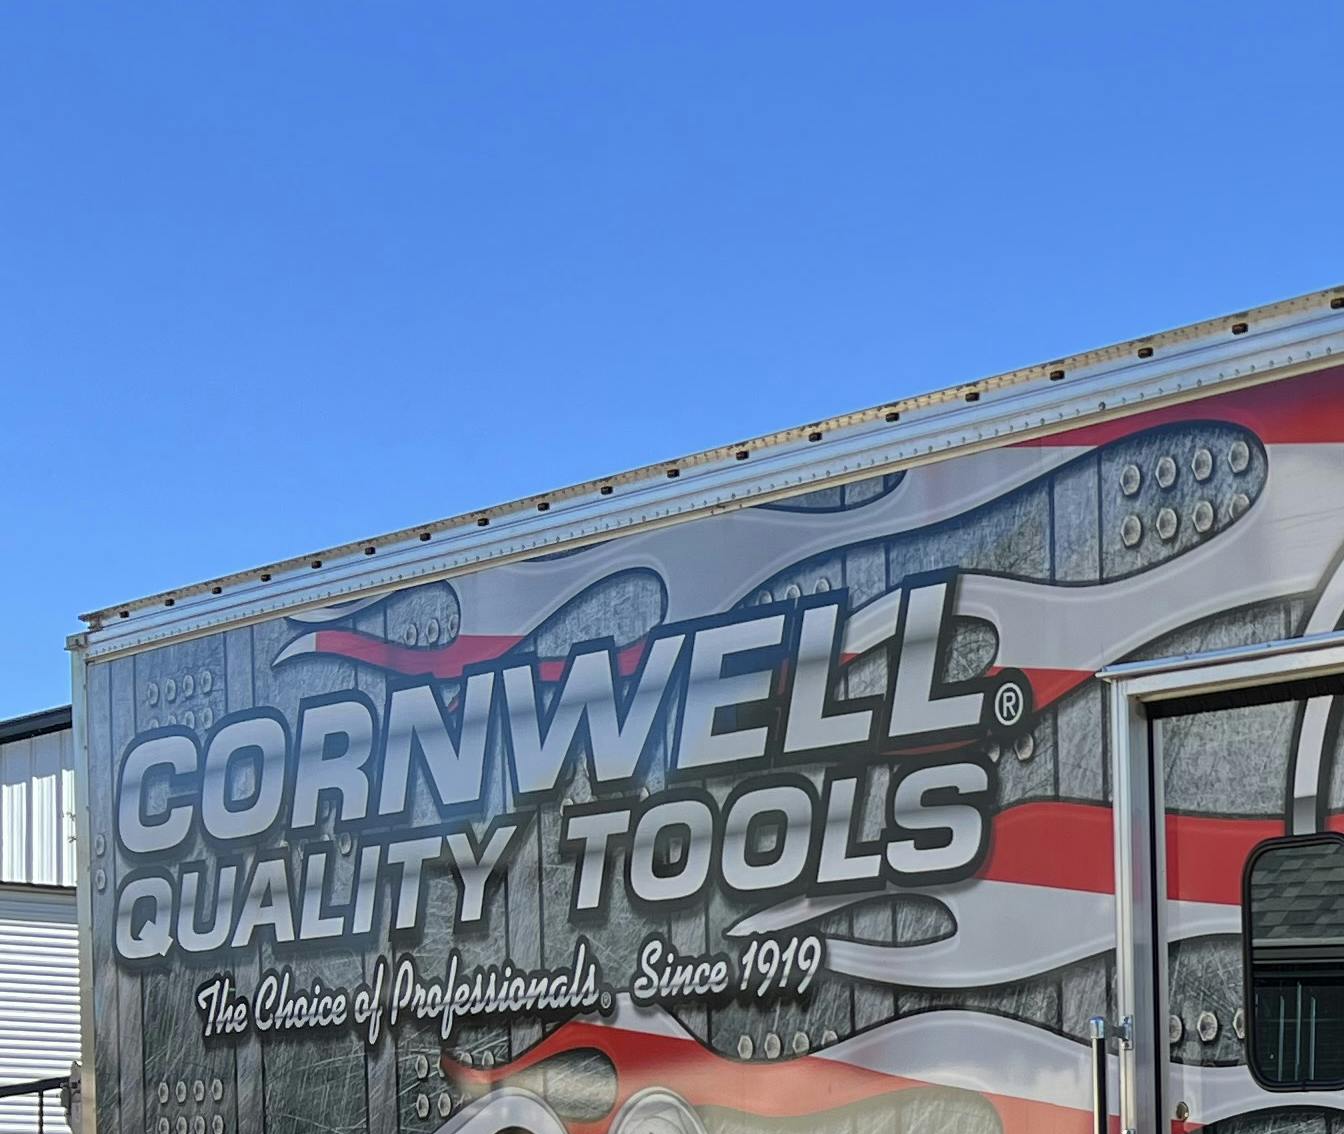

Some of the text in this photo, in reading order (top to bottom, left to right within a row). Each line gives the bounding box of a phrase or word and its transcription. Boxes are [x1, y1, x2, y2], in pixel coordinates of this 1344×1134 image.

[117, 582, 986, 855] CORNWELL
[115, 761, 990, 961] QUALITY TOOLS
[197, 935, 822, 1045] The Choice of Professionals Since 1919
